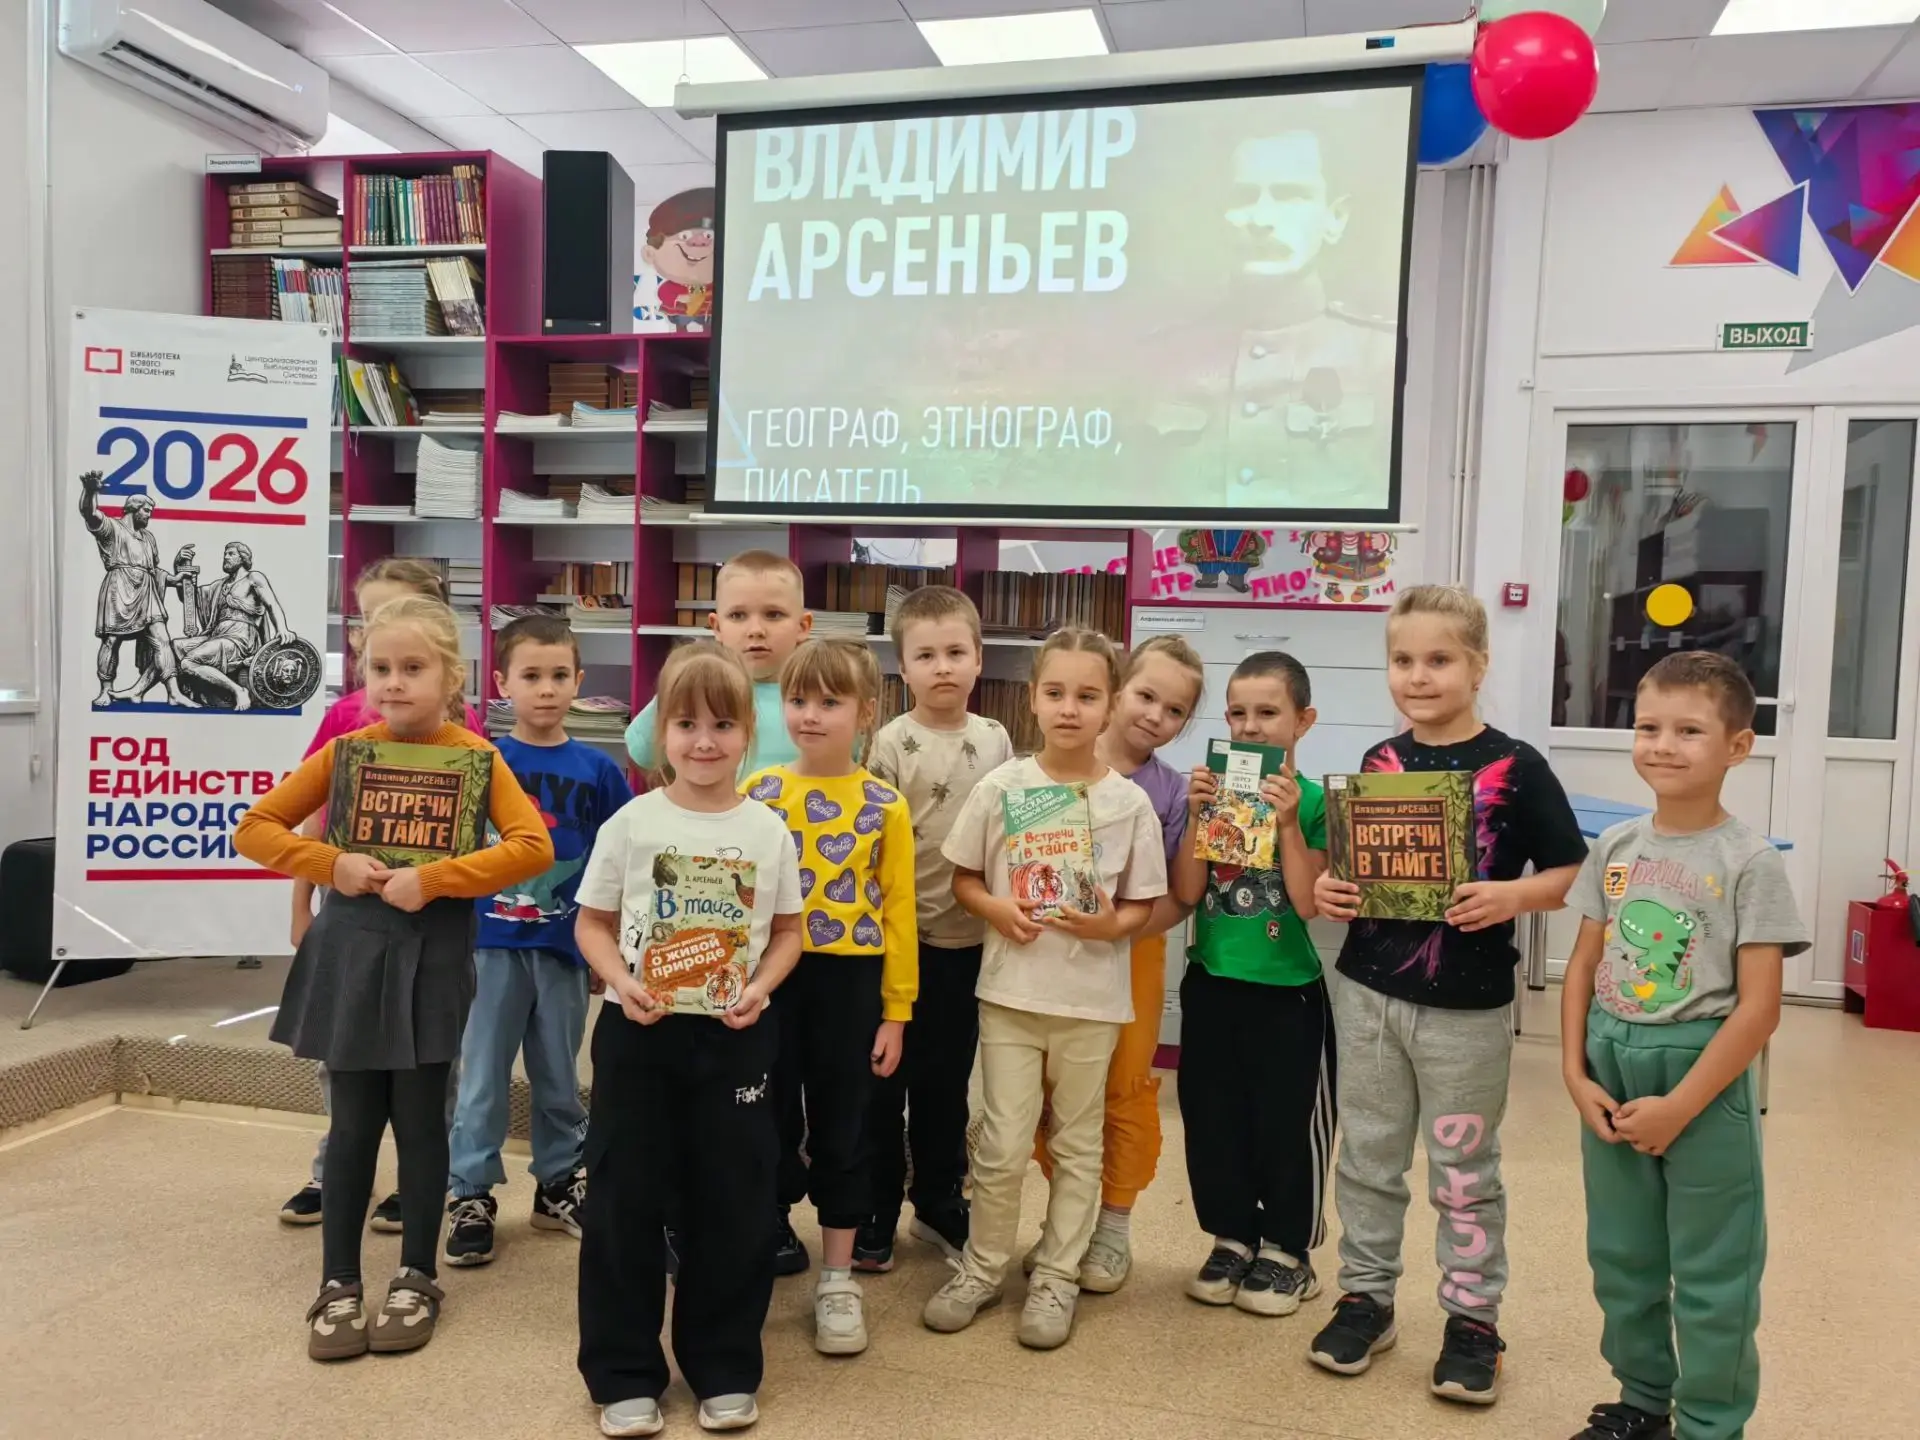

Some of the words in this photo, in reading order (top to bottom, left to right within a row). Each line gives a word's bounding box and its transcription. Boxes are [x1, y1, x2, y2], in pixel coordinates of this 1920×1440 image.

[751, 107, 1136, 204] ВЛАДИМИР
[748, 209, 1129, 301] АРСЕНЬЕВ
[1729, 326, 1801, 344] ВЫХОД
[130, 351, 181, 360] БИБЛИОТЕКА
[130, 360, 161, 368] НОВОГО
[130, 368, 175, 376] ПОКОЛЕНИЯ
[745, 407, 908, 455] ГЕОГРАФ,
[921, 404, 1124, 455] ЭТНОГРАФ,
[97, 426, 308, 505] 2026
[744, 467, 922, 504] ПИСАТЕЛЬ
[90, 736, 170, 766] ГОД
[88, 769, 293, 798] ЕДИНСТВ
[365, 771, 410, 784] Владимир
[411, 774, 457, 787] АРСЕНЬЕВ
[87, 802, 250, 831] НАРОДО
[361, 789, 454, 818] ВСТРЕЧИ
[1354, 804, 1396, 815] Владимир
[1397, 804, 1440, 814] АРСЕНЬЕВ
[356, 816, 374, 841] В
[381, 816, 451, 848] ТАЙГЕ
[1024, 828, 1074, 843] Встречи
[1356, 824, 1441, 846] ВСТРЕЧИ
[821, 839, 853, 855] Barbie
[1036, 841, 1078, 857] тайге
[1358, 852, 1372, 875] В
[1378, 848, 1444, 877] ТАЙГЕ
[692, 876, 723, 885] АРСЕНЬЕВ
[655, 888, 677, 920] В
[684, 897, 744, 923] тайге
[650, 947, 726, 980] природе
[665, 938, 720, 962] живой
